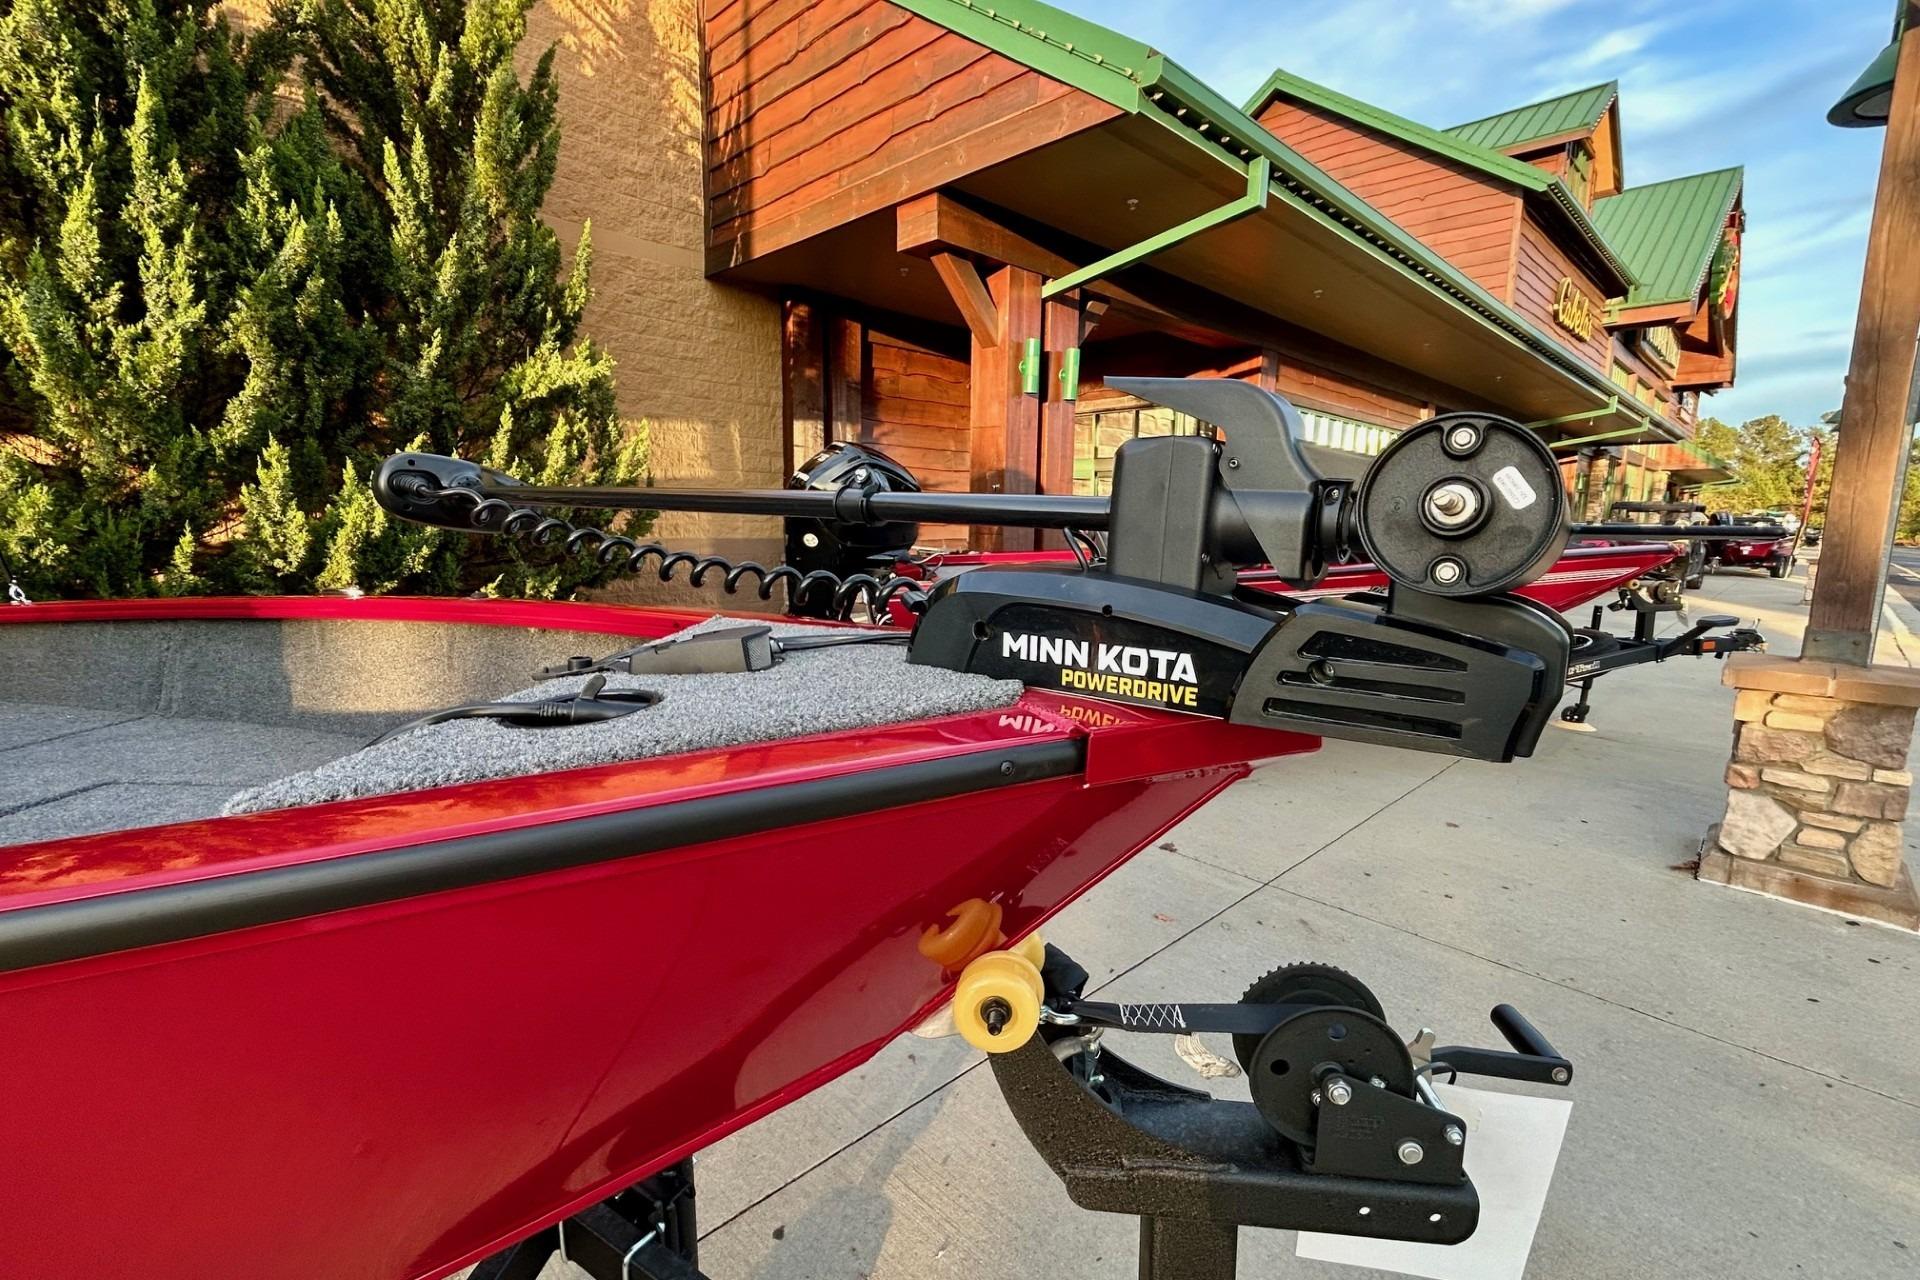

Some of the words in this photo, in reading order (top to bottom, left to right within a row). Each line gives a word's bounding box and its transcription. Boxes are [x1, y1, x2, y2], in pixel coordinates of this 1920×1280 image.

[1002, 631, 1089, 668] MINN
[1097, 643, 1198, 684] KOTA
[1061, 668, 1198, 707] POWERDRIVE
